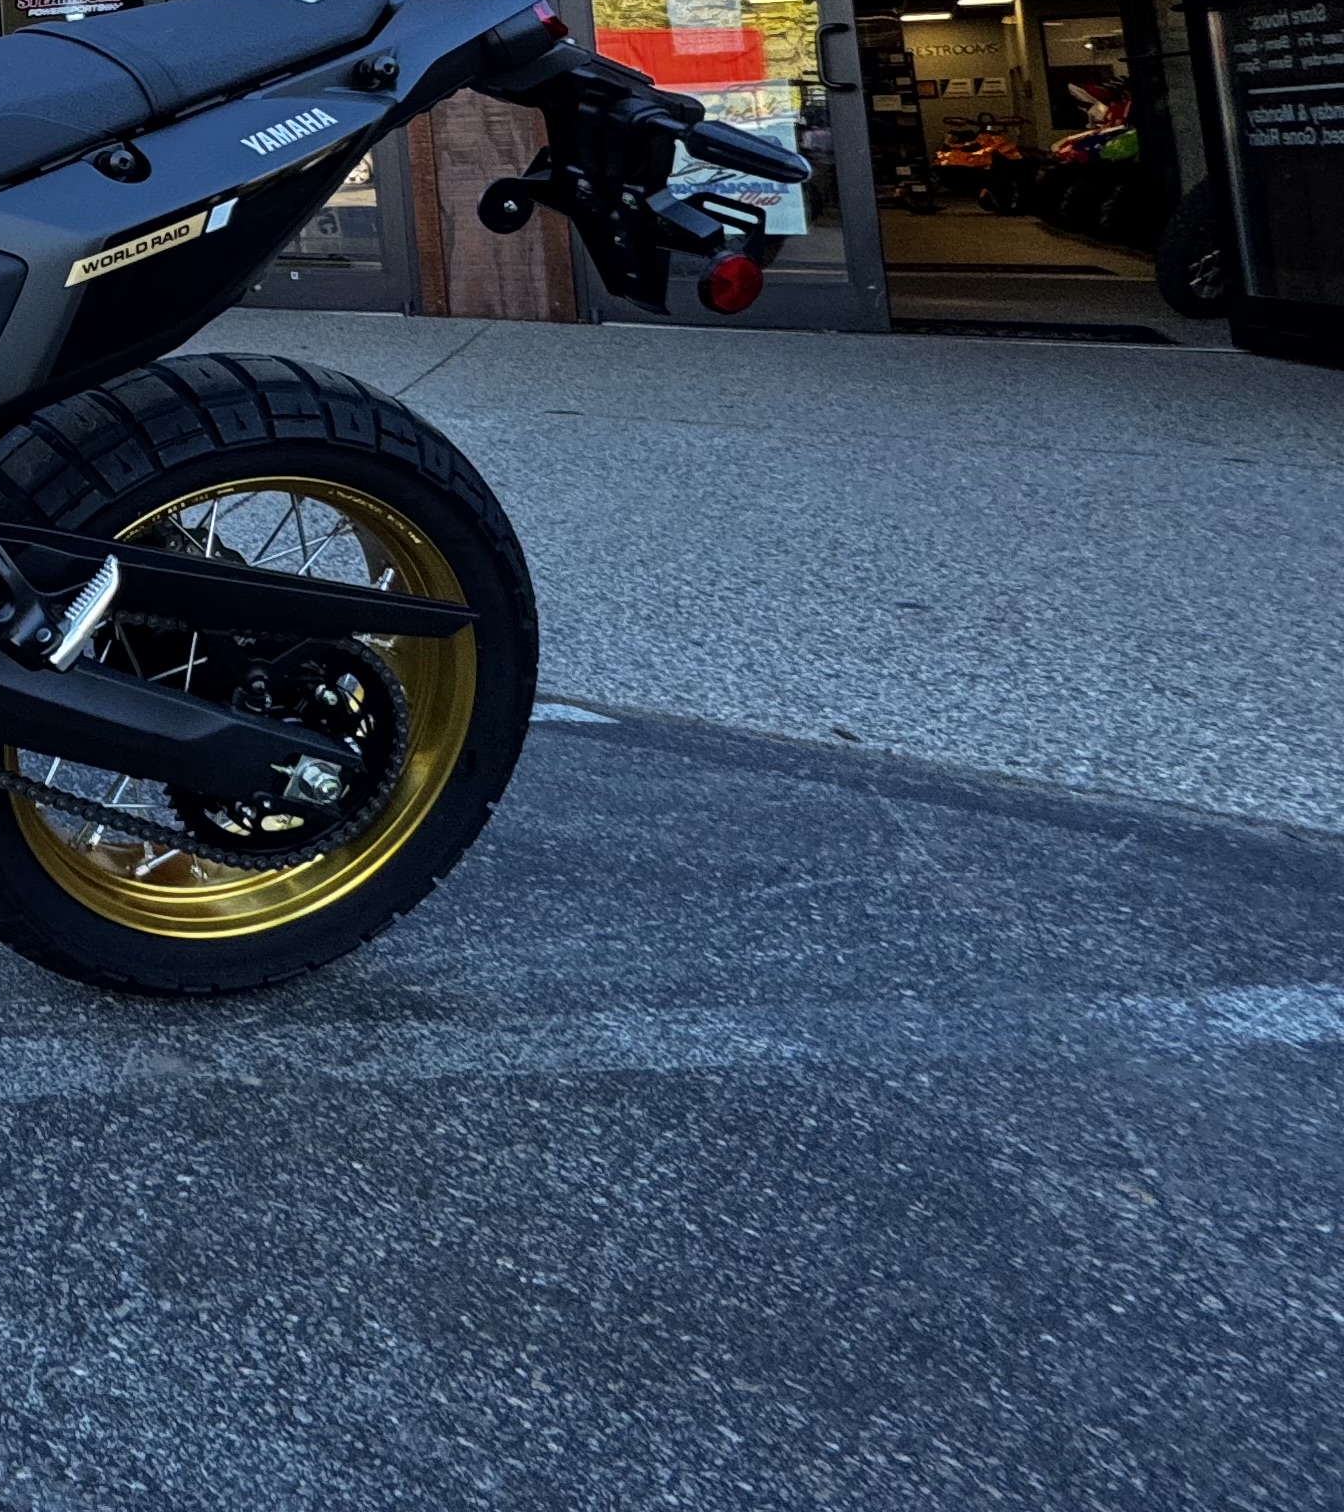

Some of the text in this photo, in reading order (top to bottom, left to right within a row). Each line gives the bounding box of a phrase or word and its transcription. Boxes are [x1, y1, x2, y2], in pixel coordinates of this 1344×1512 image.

[240, 108, 339, 155] YAMAHA
[81, 224, 191, 275] WORLD RAID
